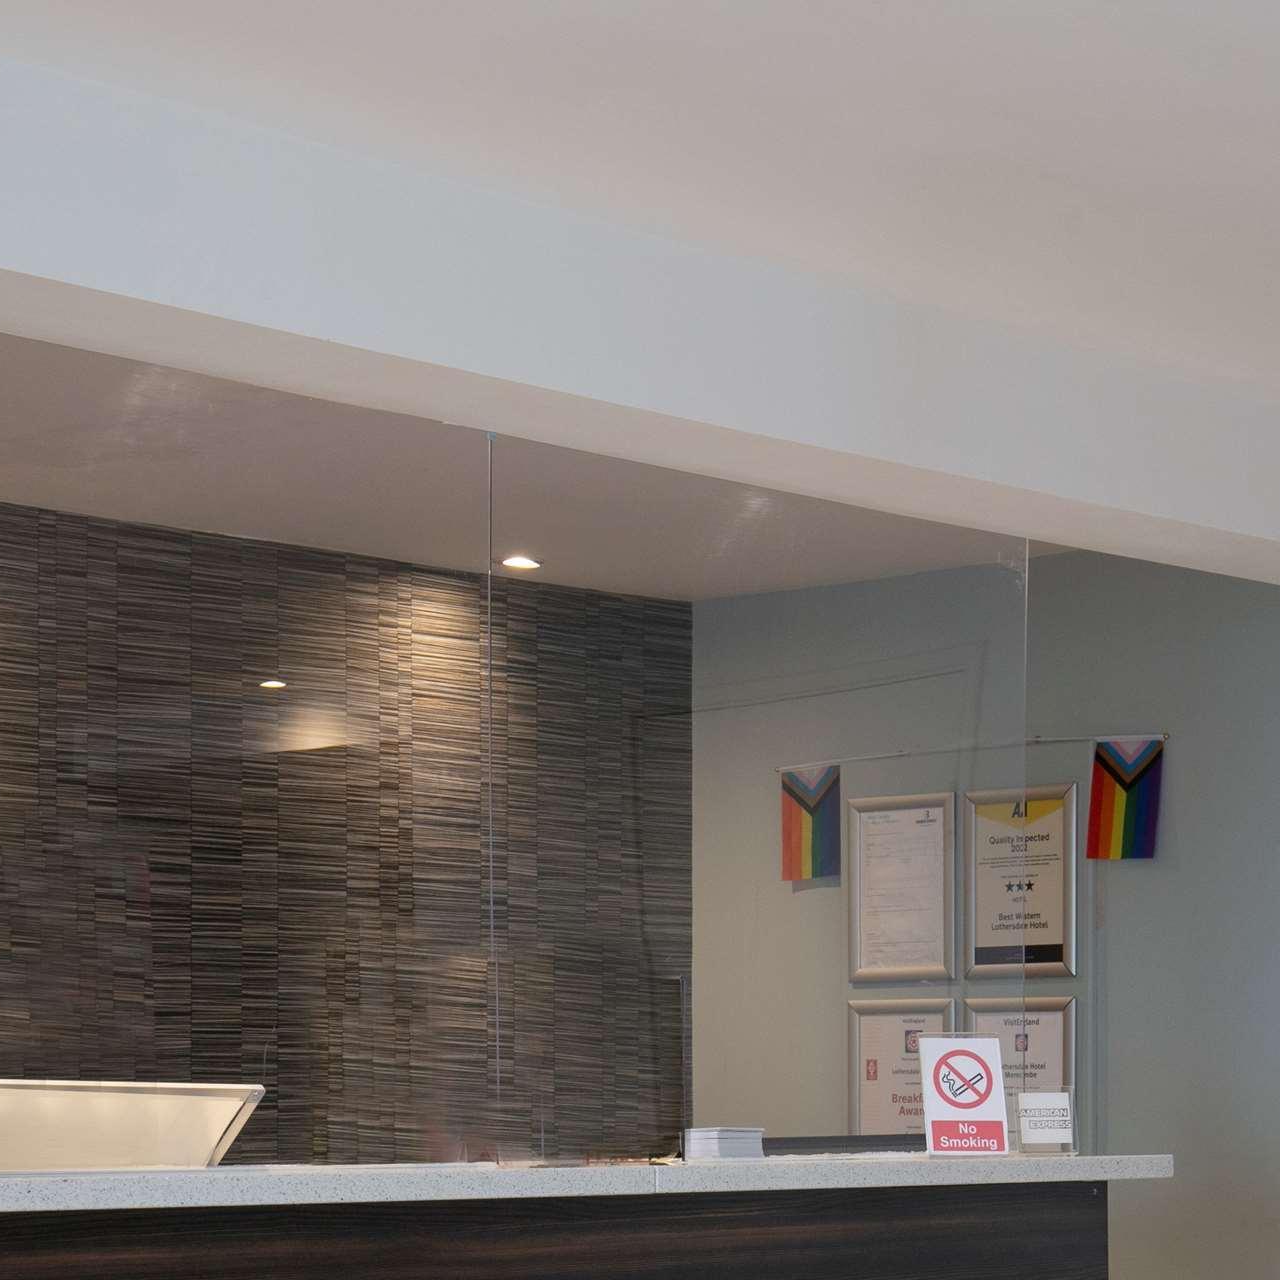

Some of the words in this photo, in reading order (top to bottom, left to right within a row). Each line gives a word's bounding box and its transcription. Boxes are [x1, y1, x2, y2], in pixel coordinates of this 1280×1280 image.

[988, 835, 1015, 846] Quality
[998, 912, 1014, 921] Best
[1029, 920, 1049, 930] Hotel
[1029, 1062, 1047, 1071] Hotel
[1017, 1108, 1069, 1118] AMERICAN
[958, 1122, 977, 1134] No
[1028, 1120, 1073, 1130] EXPRESS
[940, 1136, 998, 1151] Smoking
